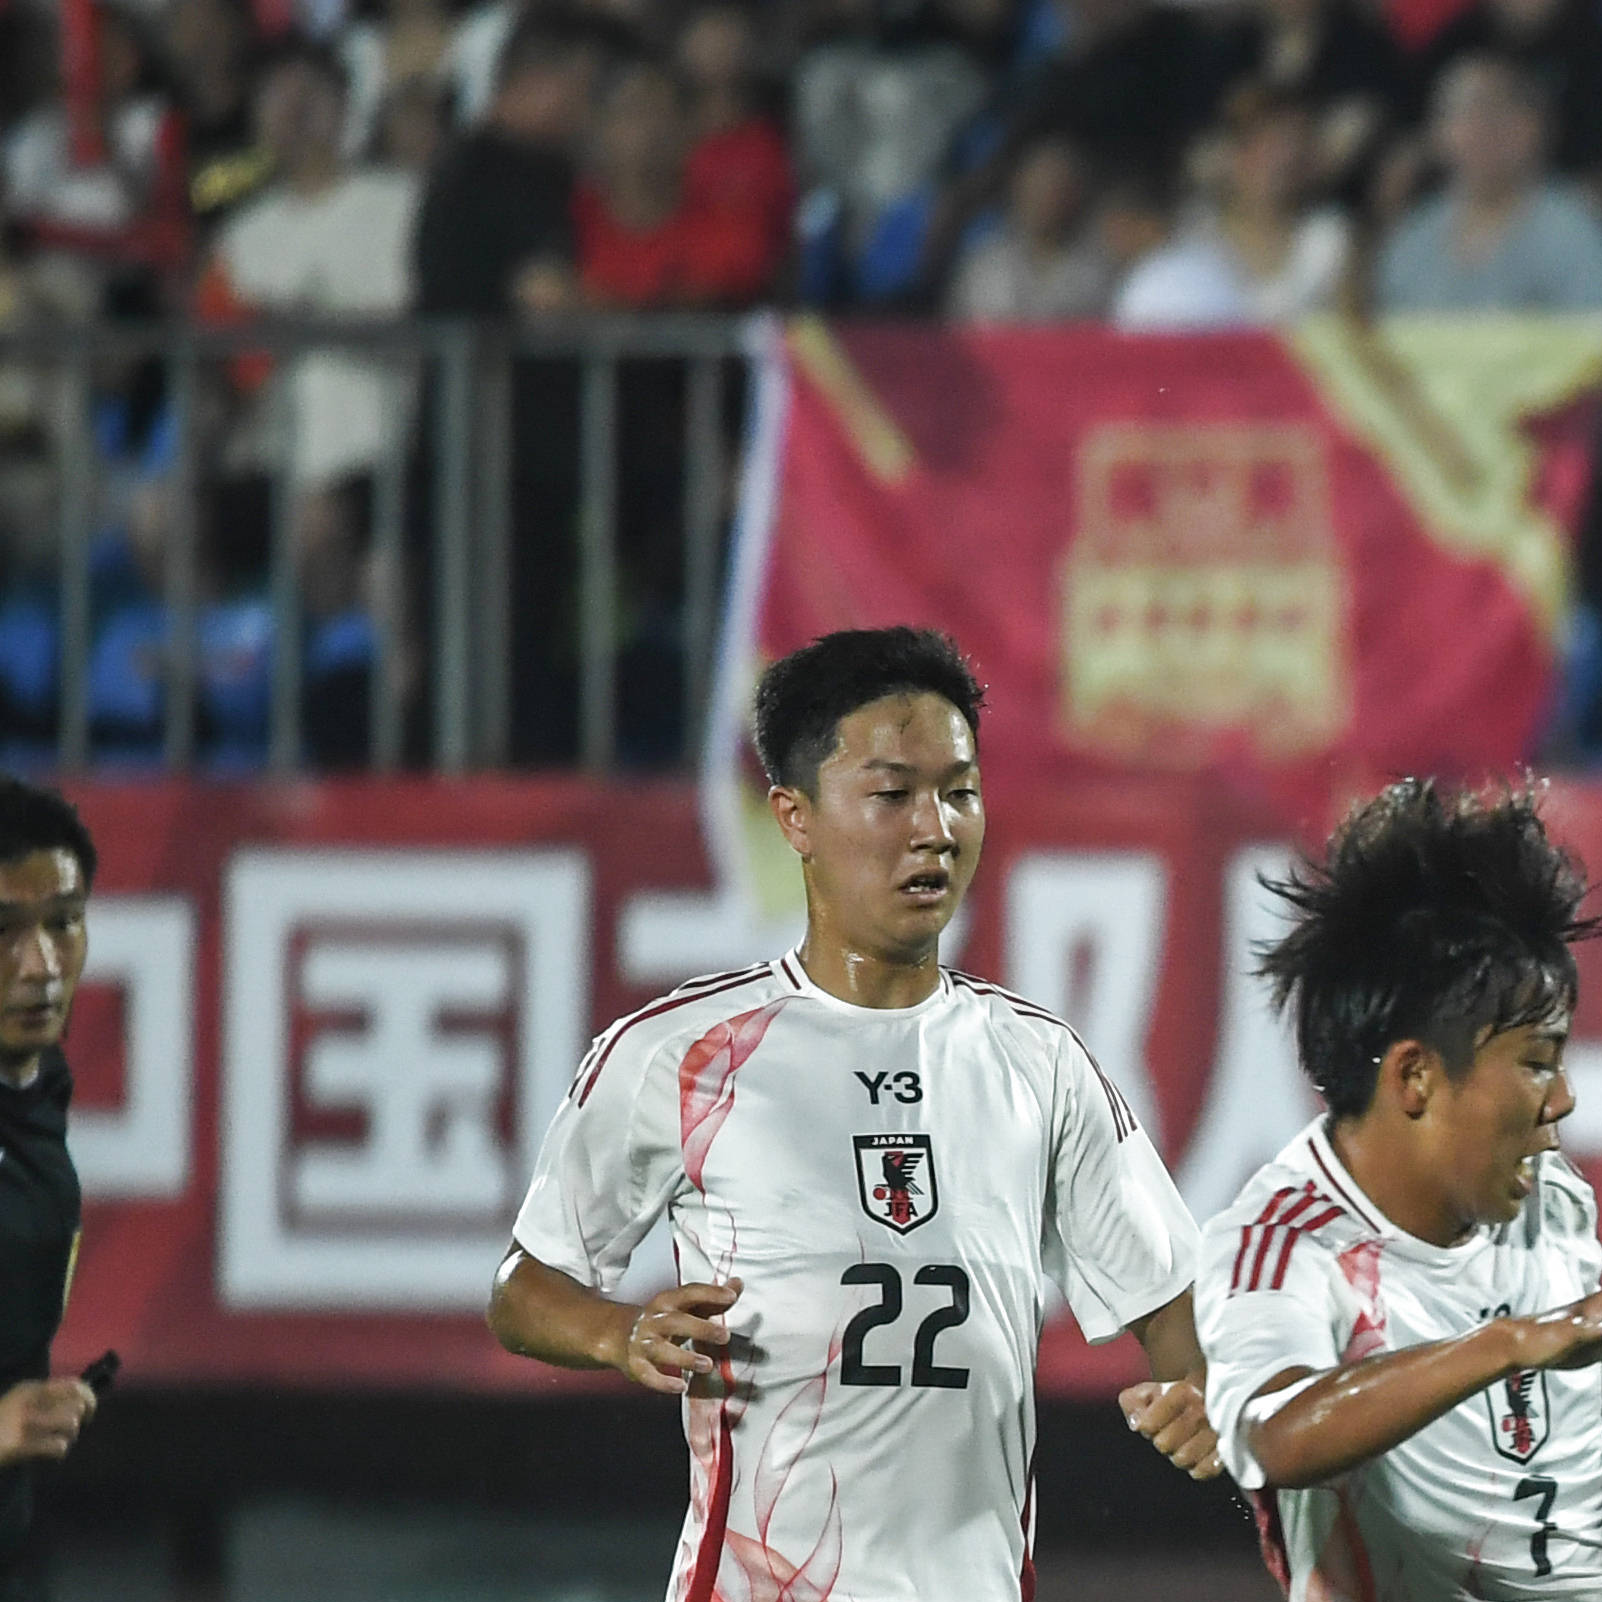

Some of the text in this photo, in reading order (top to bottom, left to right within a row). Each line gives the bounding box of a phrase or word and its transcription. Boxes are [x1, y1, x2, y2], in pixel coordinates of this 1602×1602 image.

[853, 1070, 924, 1105] Y-3
[871, 1136, 914, 1146] JAPAN
[840, 1262, 970, 1390] 22
[1512, 1474, 1559, 1578] 7
